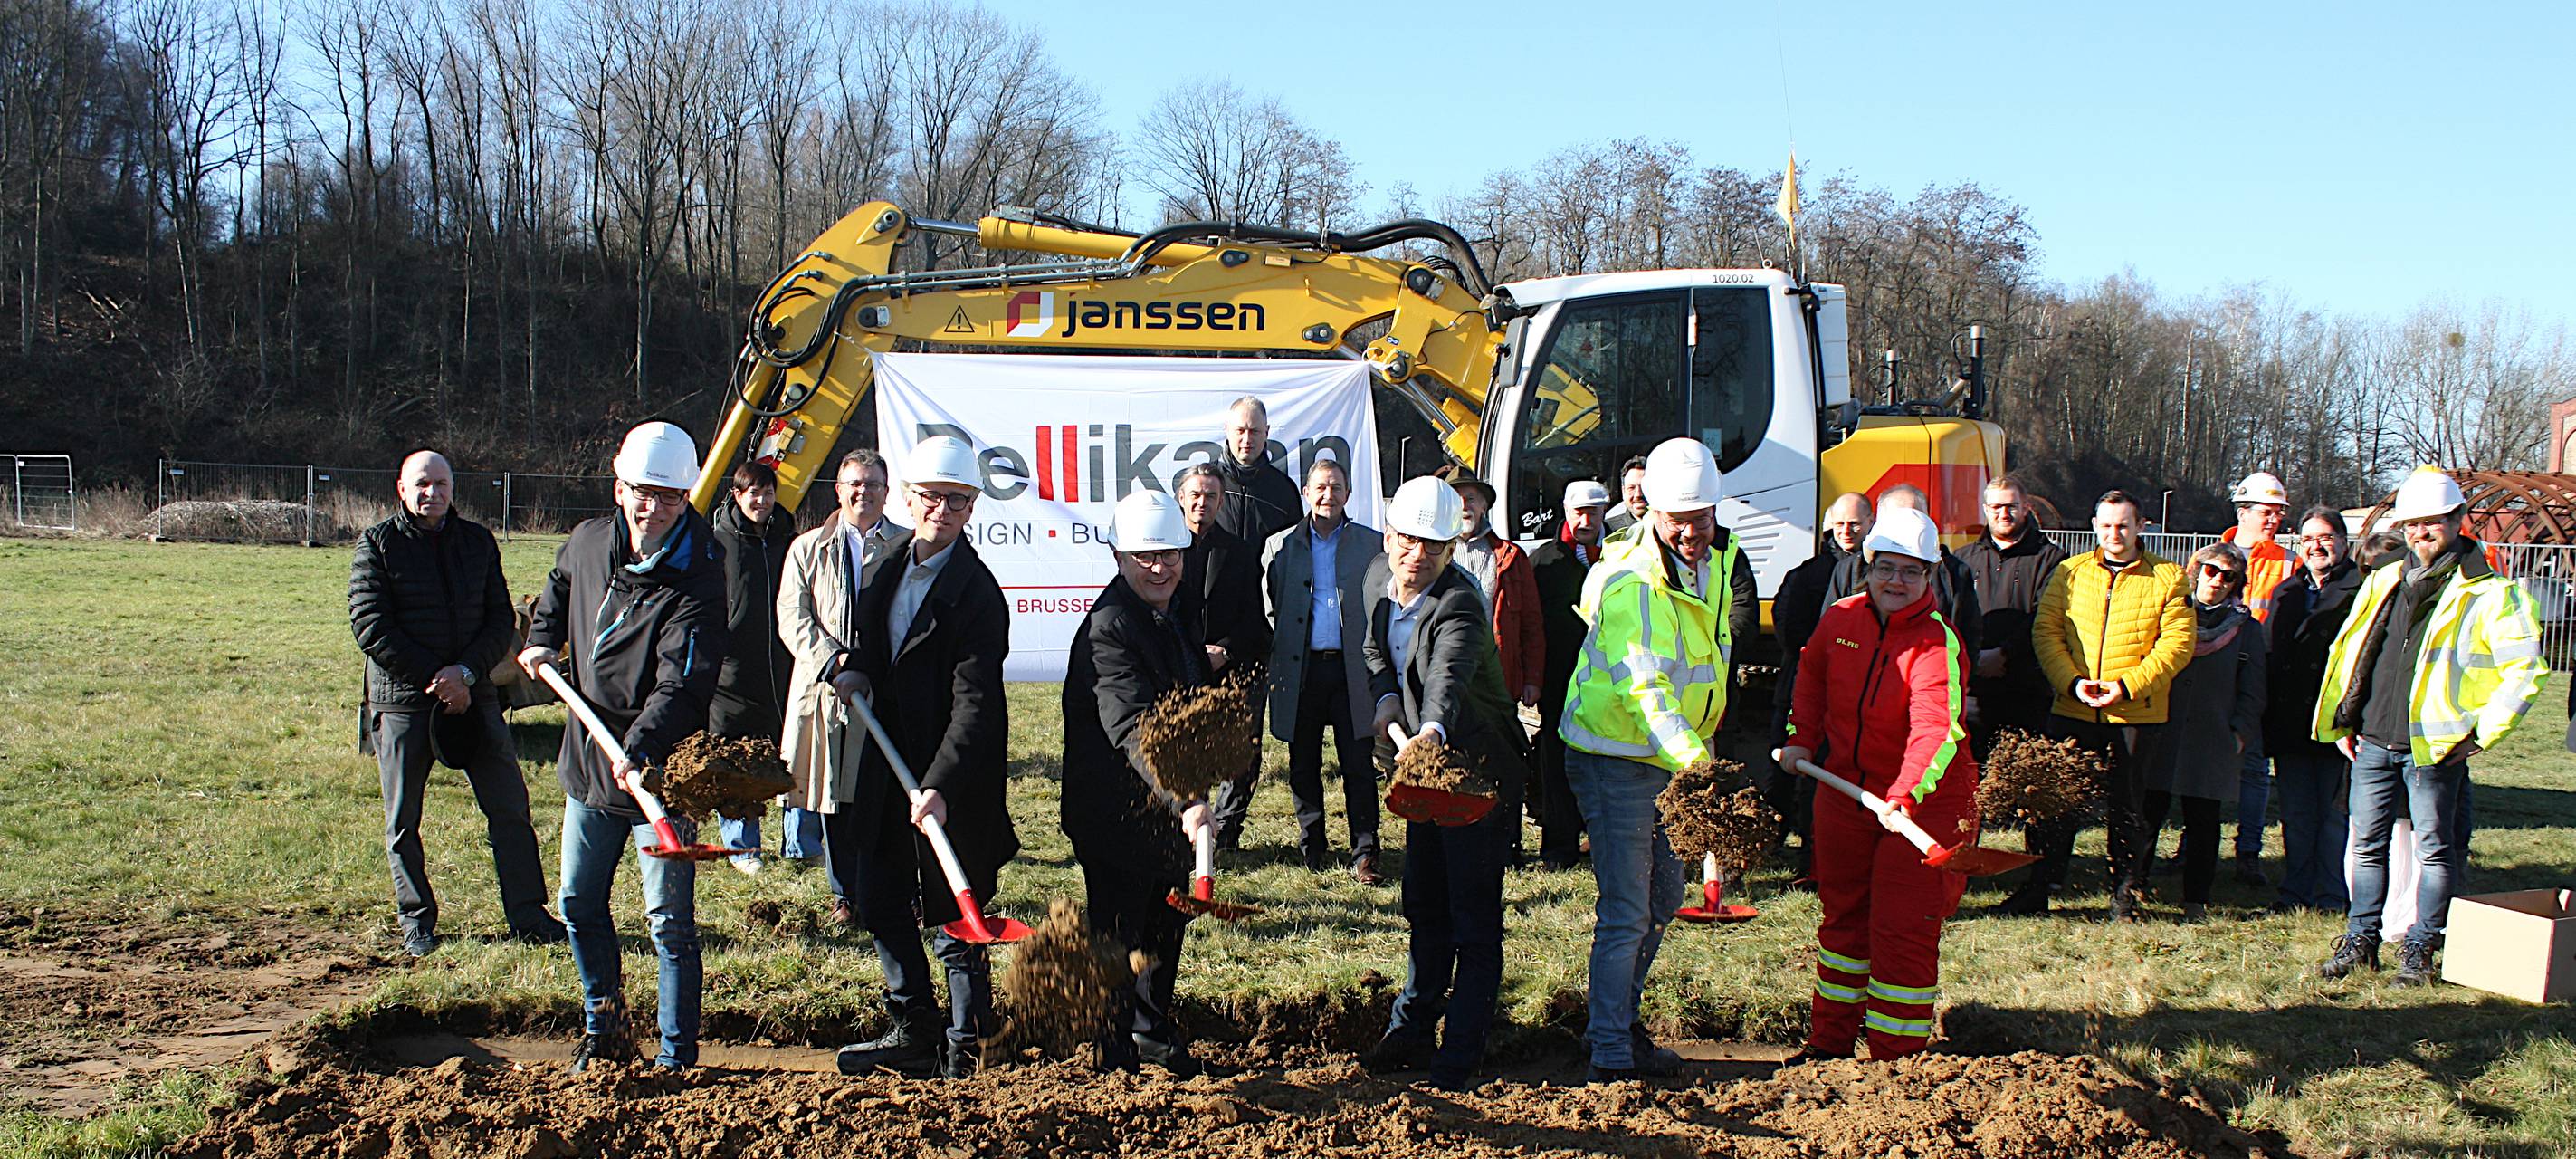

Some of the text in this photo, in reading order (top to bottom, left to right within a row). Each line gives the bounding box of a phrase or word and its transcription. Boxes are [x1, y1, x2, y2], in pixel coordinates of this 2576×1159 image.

[1713, 274, 1754, 283] 1020.02
[1061, 292, 1265, 338] janssen
[1521, 508, 1553, 527] Bart
